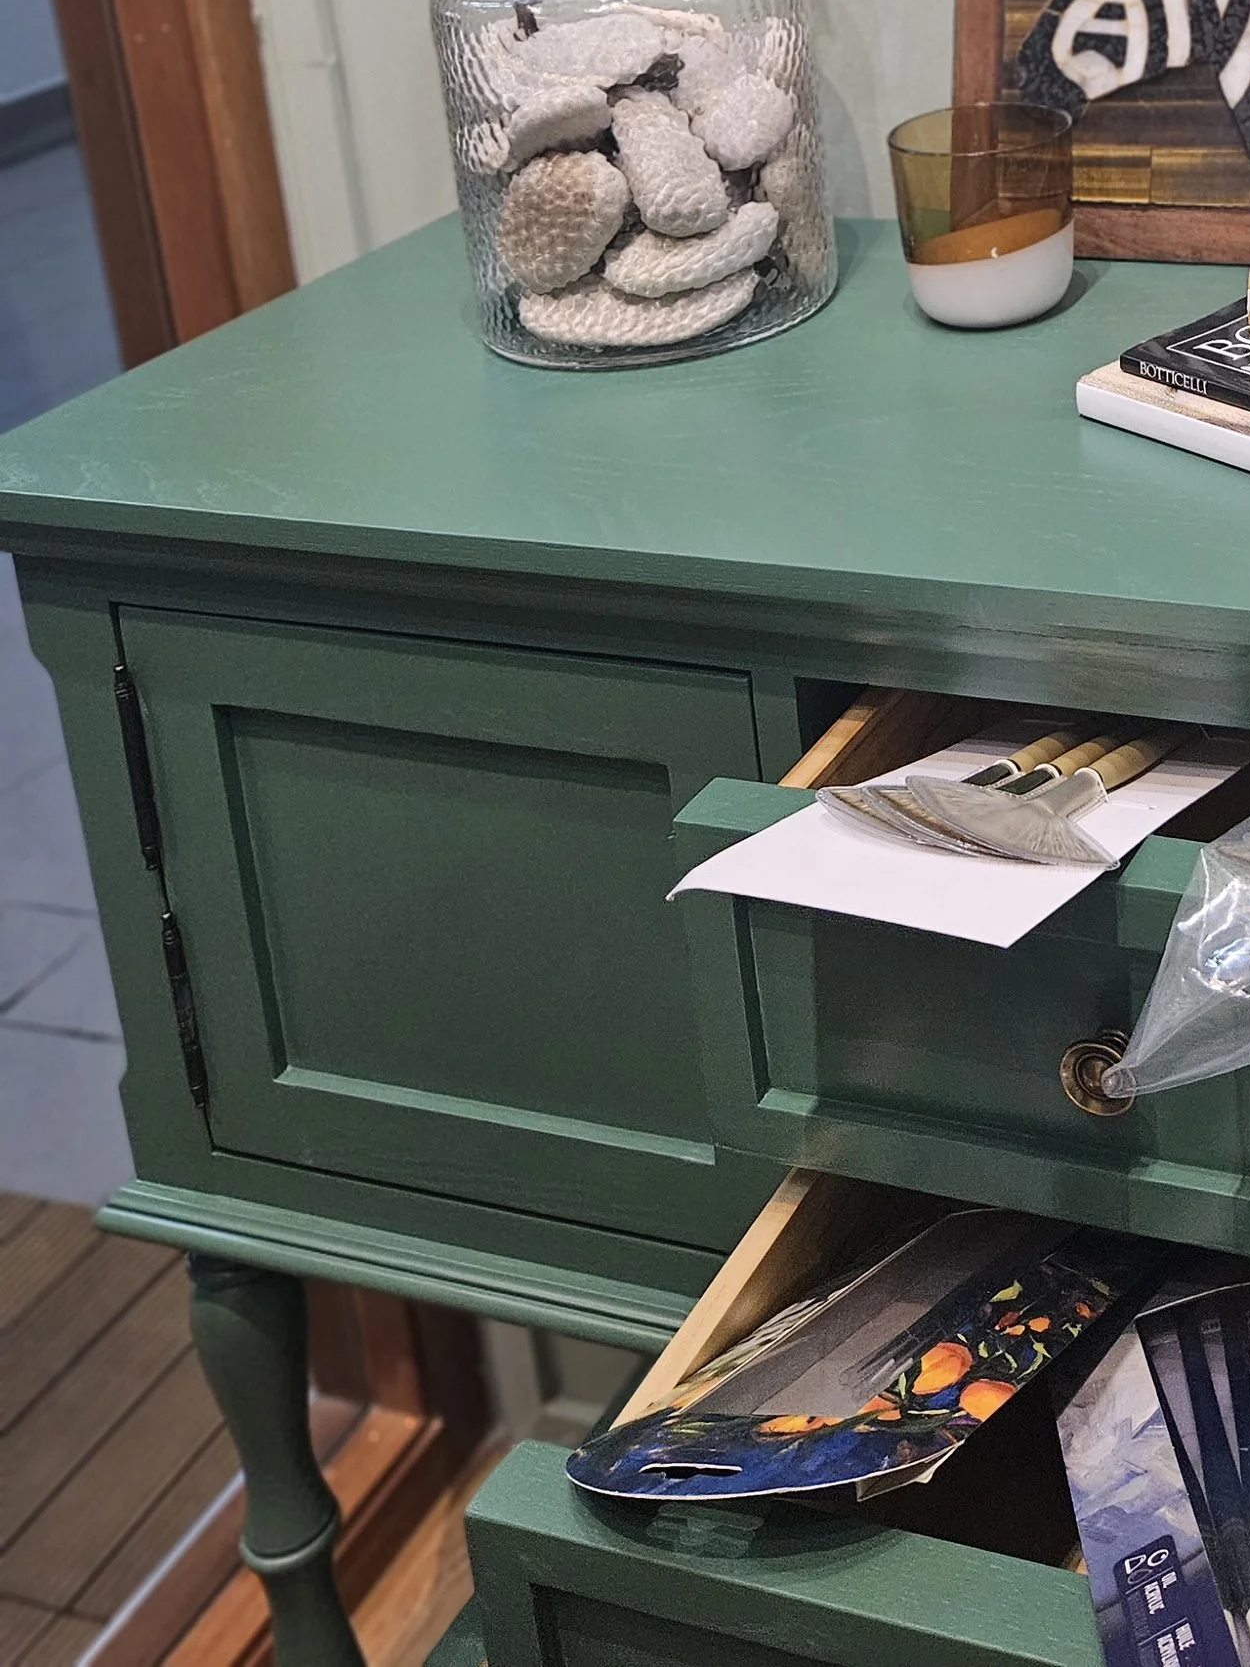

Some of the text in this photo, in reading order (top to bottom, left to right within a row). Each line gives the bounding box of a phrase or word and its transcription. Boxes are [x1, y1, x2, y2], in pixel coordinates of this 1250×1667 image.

[1139, 360, 1209, 396] BOTTICELLI
[1162, 1571, 1177, 1589] OIL
[1144, 1581, 1165, 1614] ACRYLIC
[1175, 1623, 1196, 1651] HUILE
